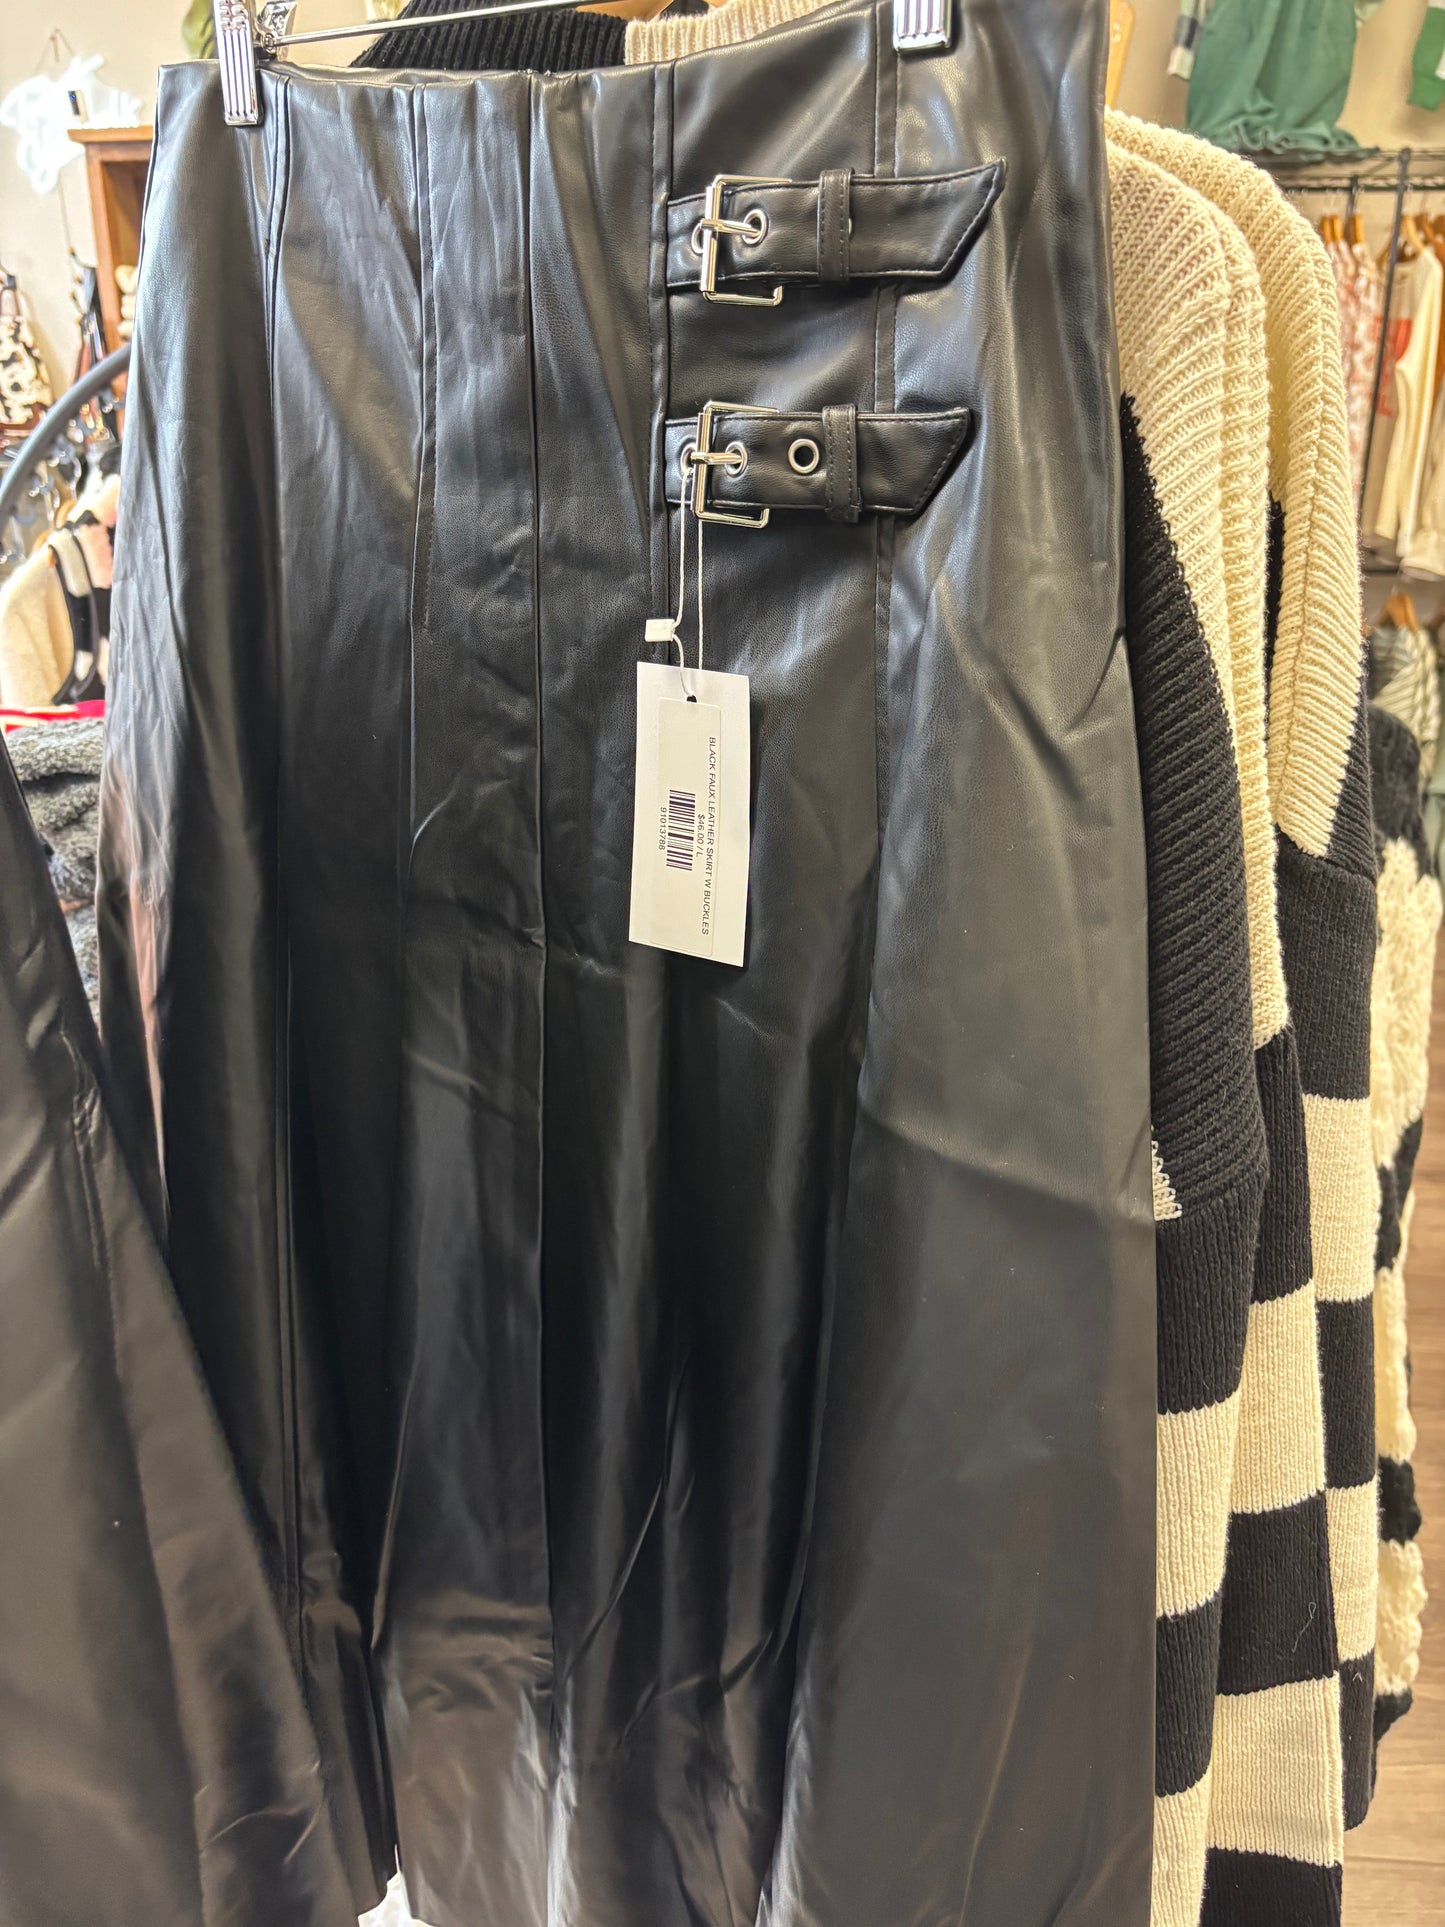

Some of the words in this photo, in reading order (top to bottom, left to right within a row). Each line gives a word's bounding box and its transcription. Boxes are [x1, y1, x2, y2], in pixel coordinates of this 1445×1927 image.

[708, 773, 716, 799] FAUX
[658, 807, 667, 850] 91013788
[697, 814, 705, 845] $46.00
[707, 801, 715, 846] LEATHER
[705, 848, 714, 877] SKIRT
[704, 879, 712, 888] W
[701, 890, 711, 935] BUCKLES
